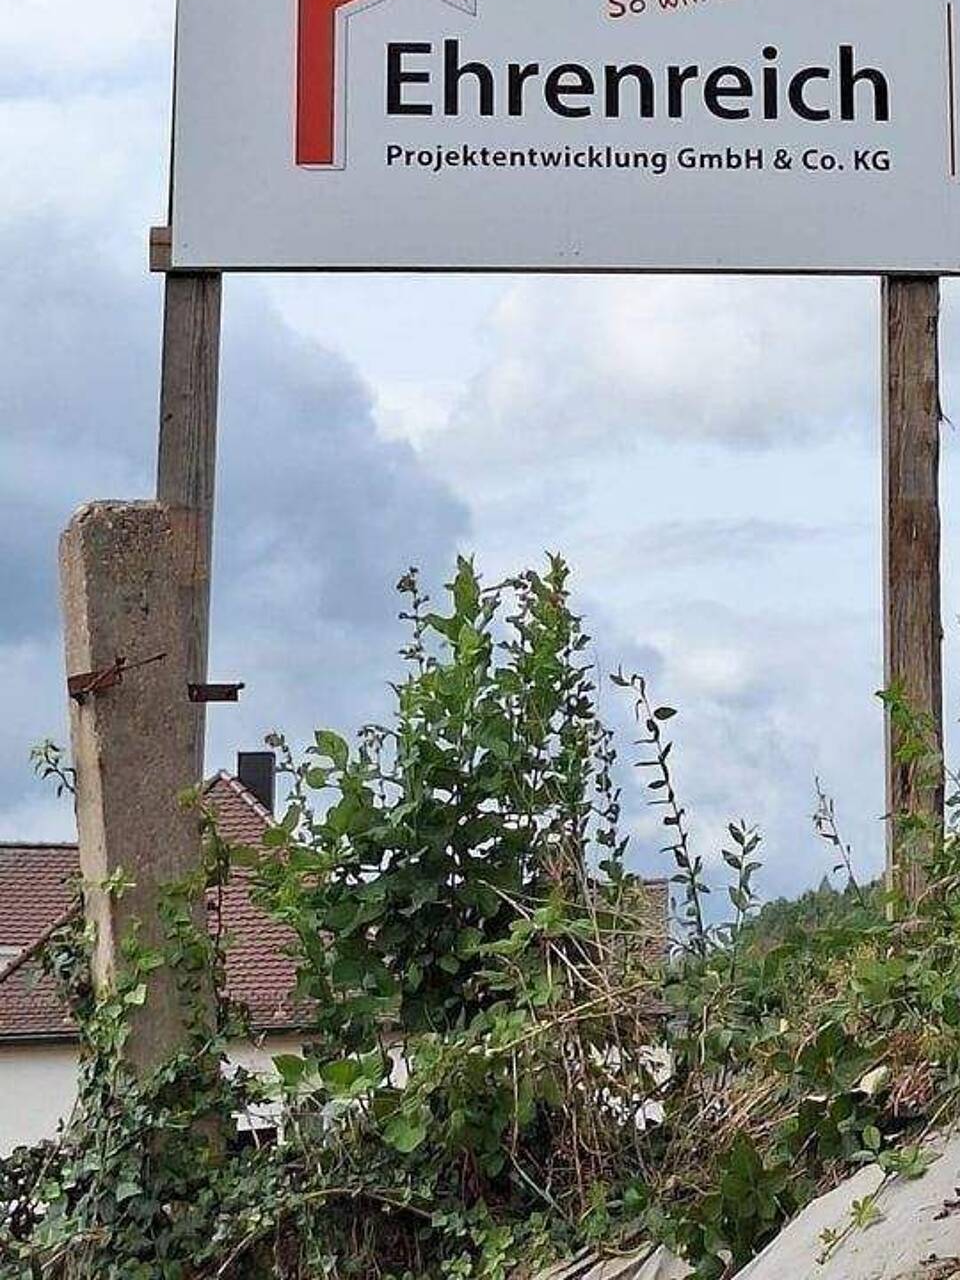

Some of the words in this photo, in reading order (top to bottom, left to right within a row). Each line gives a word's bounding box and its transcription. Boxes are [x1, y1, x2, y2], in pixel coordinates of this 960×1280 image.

[386, 39, 890, 121] Ehrenreich
[386, 144, 668, 175] Projektentwicklung
[677, 147, 763, 170] GmbH
[774, 149, 792, 171] &
[801, 149, 844, 171] Co.
[854, 149, 890, 172] KG
